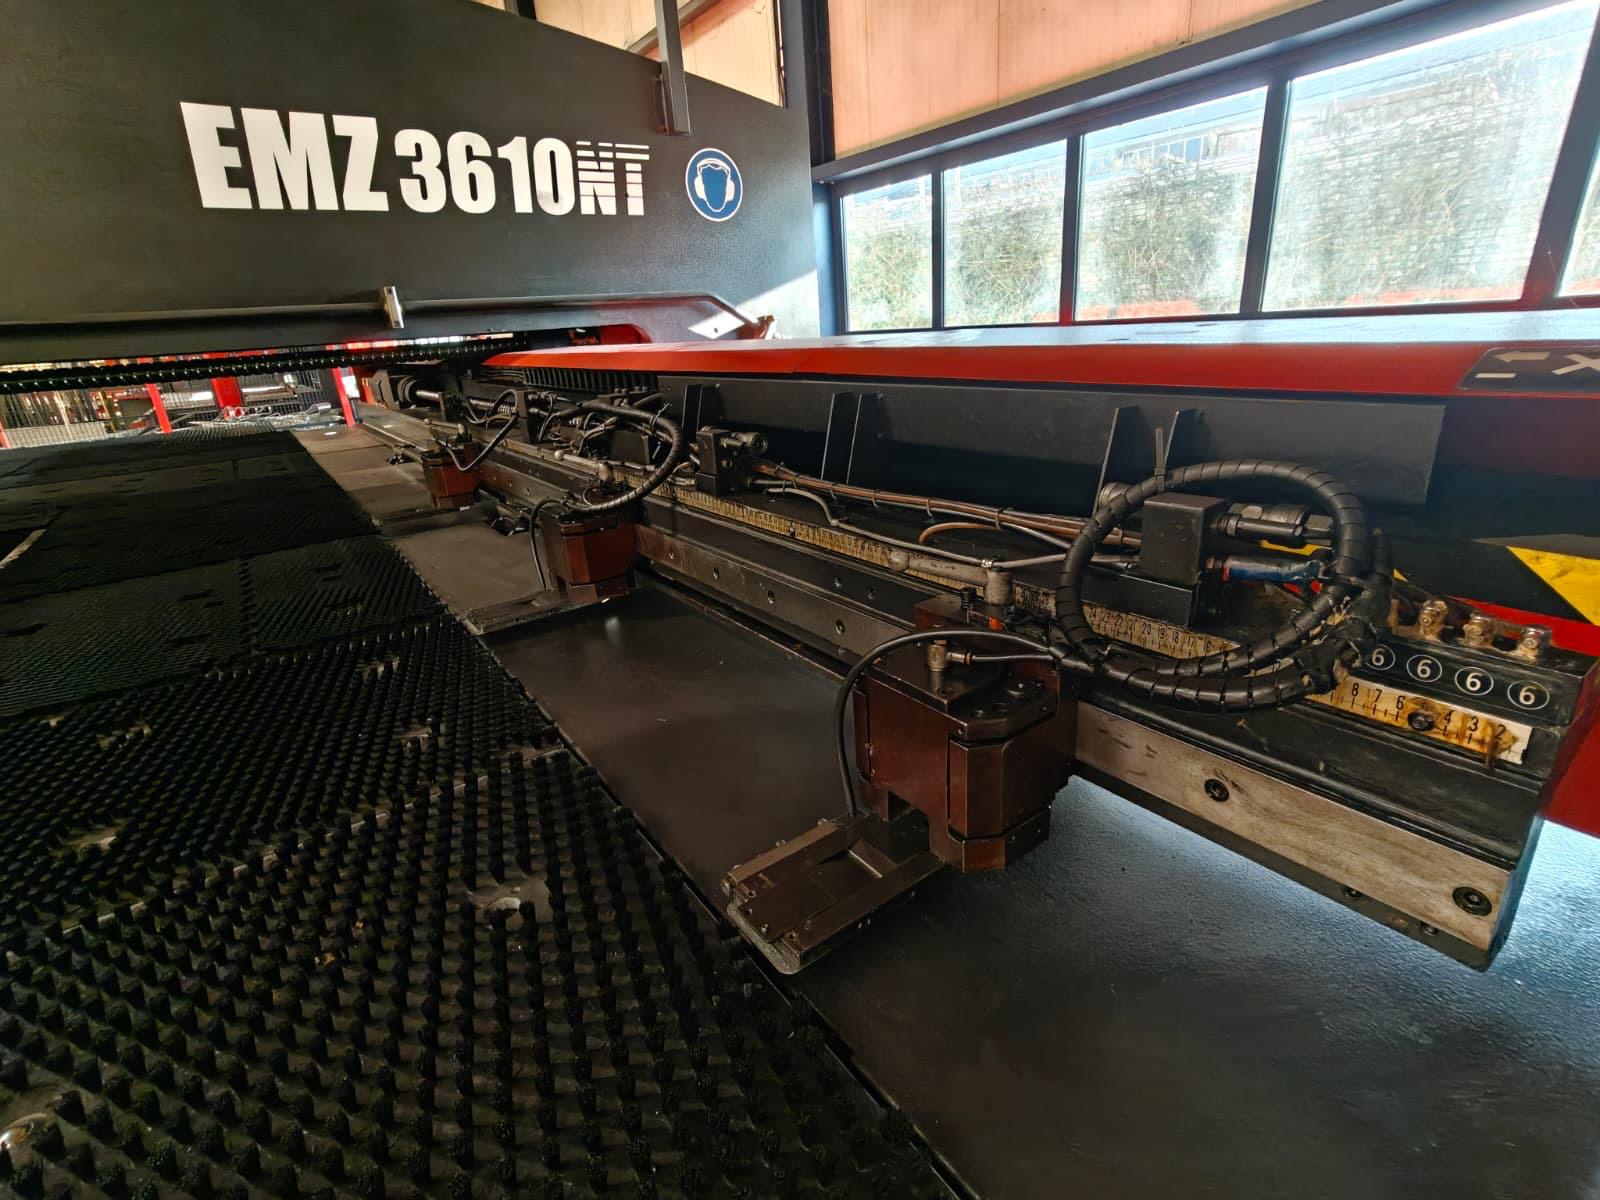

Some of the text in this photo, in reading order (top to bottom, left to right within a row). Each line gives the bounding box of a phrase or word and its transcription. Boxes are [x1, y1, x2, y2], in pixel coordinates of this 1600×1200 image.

[180, 101, 389, 212] EMZ
[1141, 622, 1151, 635] 20
[1158, 626, 1165, 639] 19
[1172, 629, 1179, 644] 18
[1372, 648, 1537, 705] 6 6 6 6
[1351, 682, 1506, 740] 8 7 6 4 3 2
